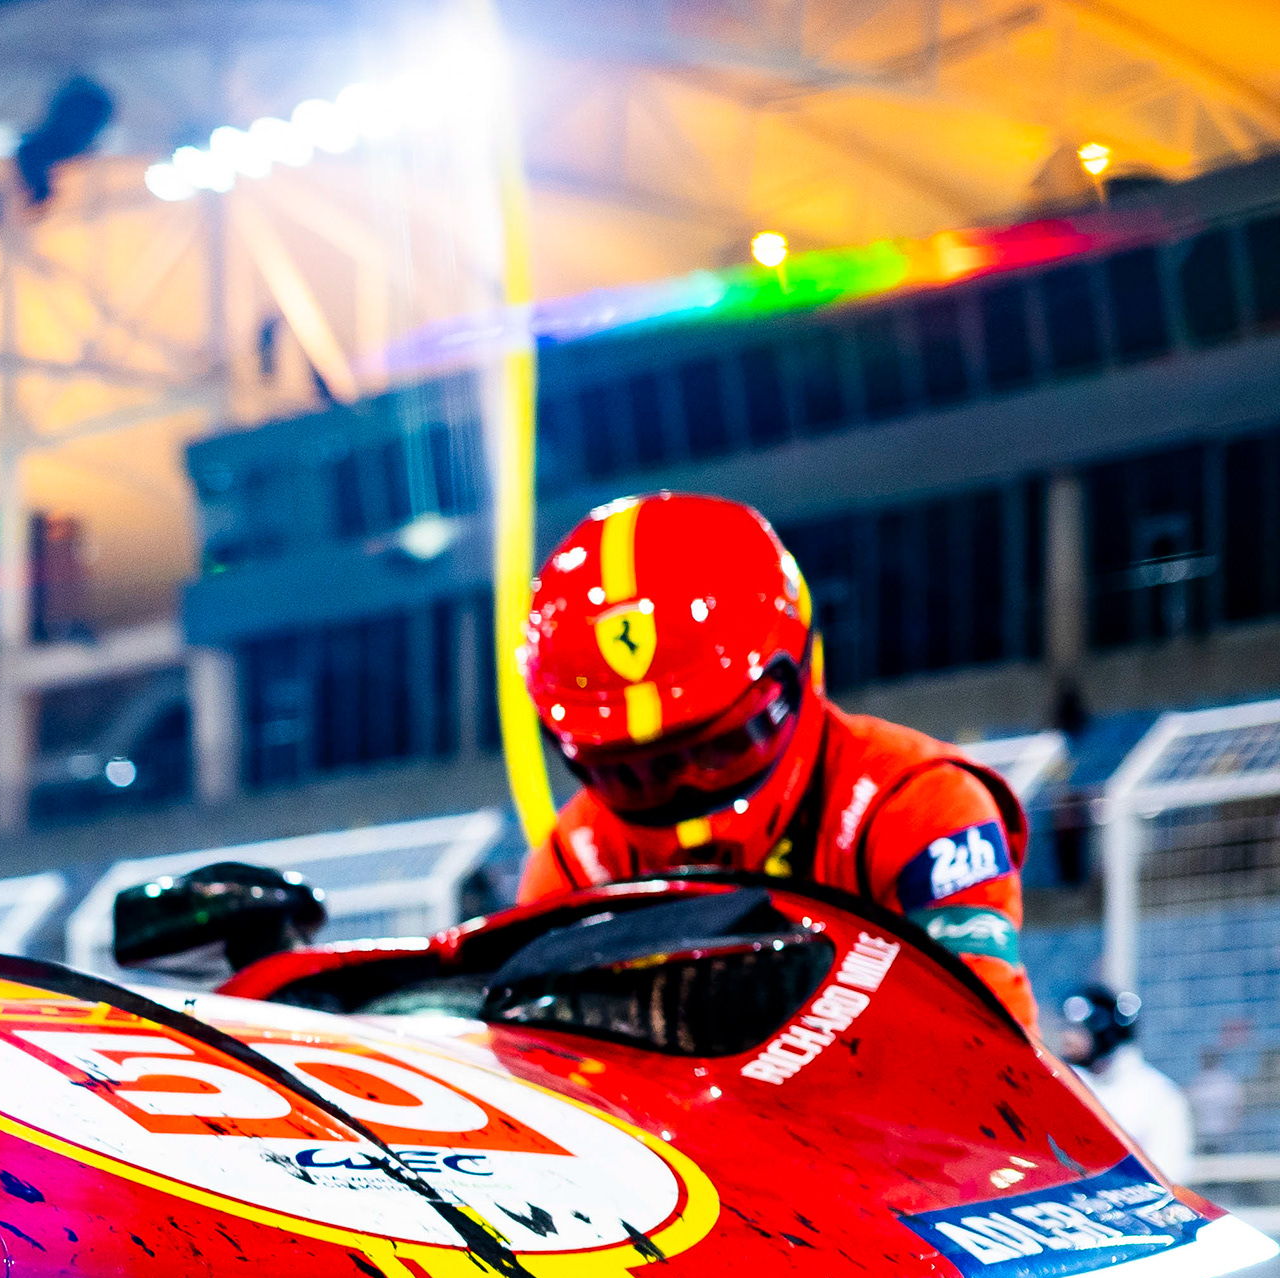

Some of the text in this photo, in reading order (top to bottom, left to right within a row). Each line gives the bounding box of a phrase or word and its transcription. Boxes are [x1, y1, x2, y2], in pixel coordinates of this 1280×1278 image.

[741, 984, 870, 1085] RICHARD
[836, 931, 901, 992] MILLE
[10, 1028, 490, 1132] 50
[935, 1202, 1125, 1265] ADLER
